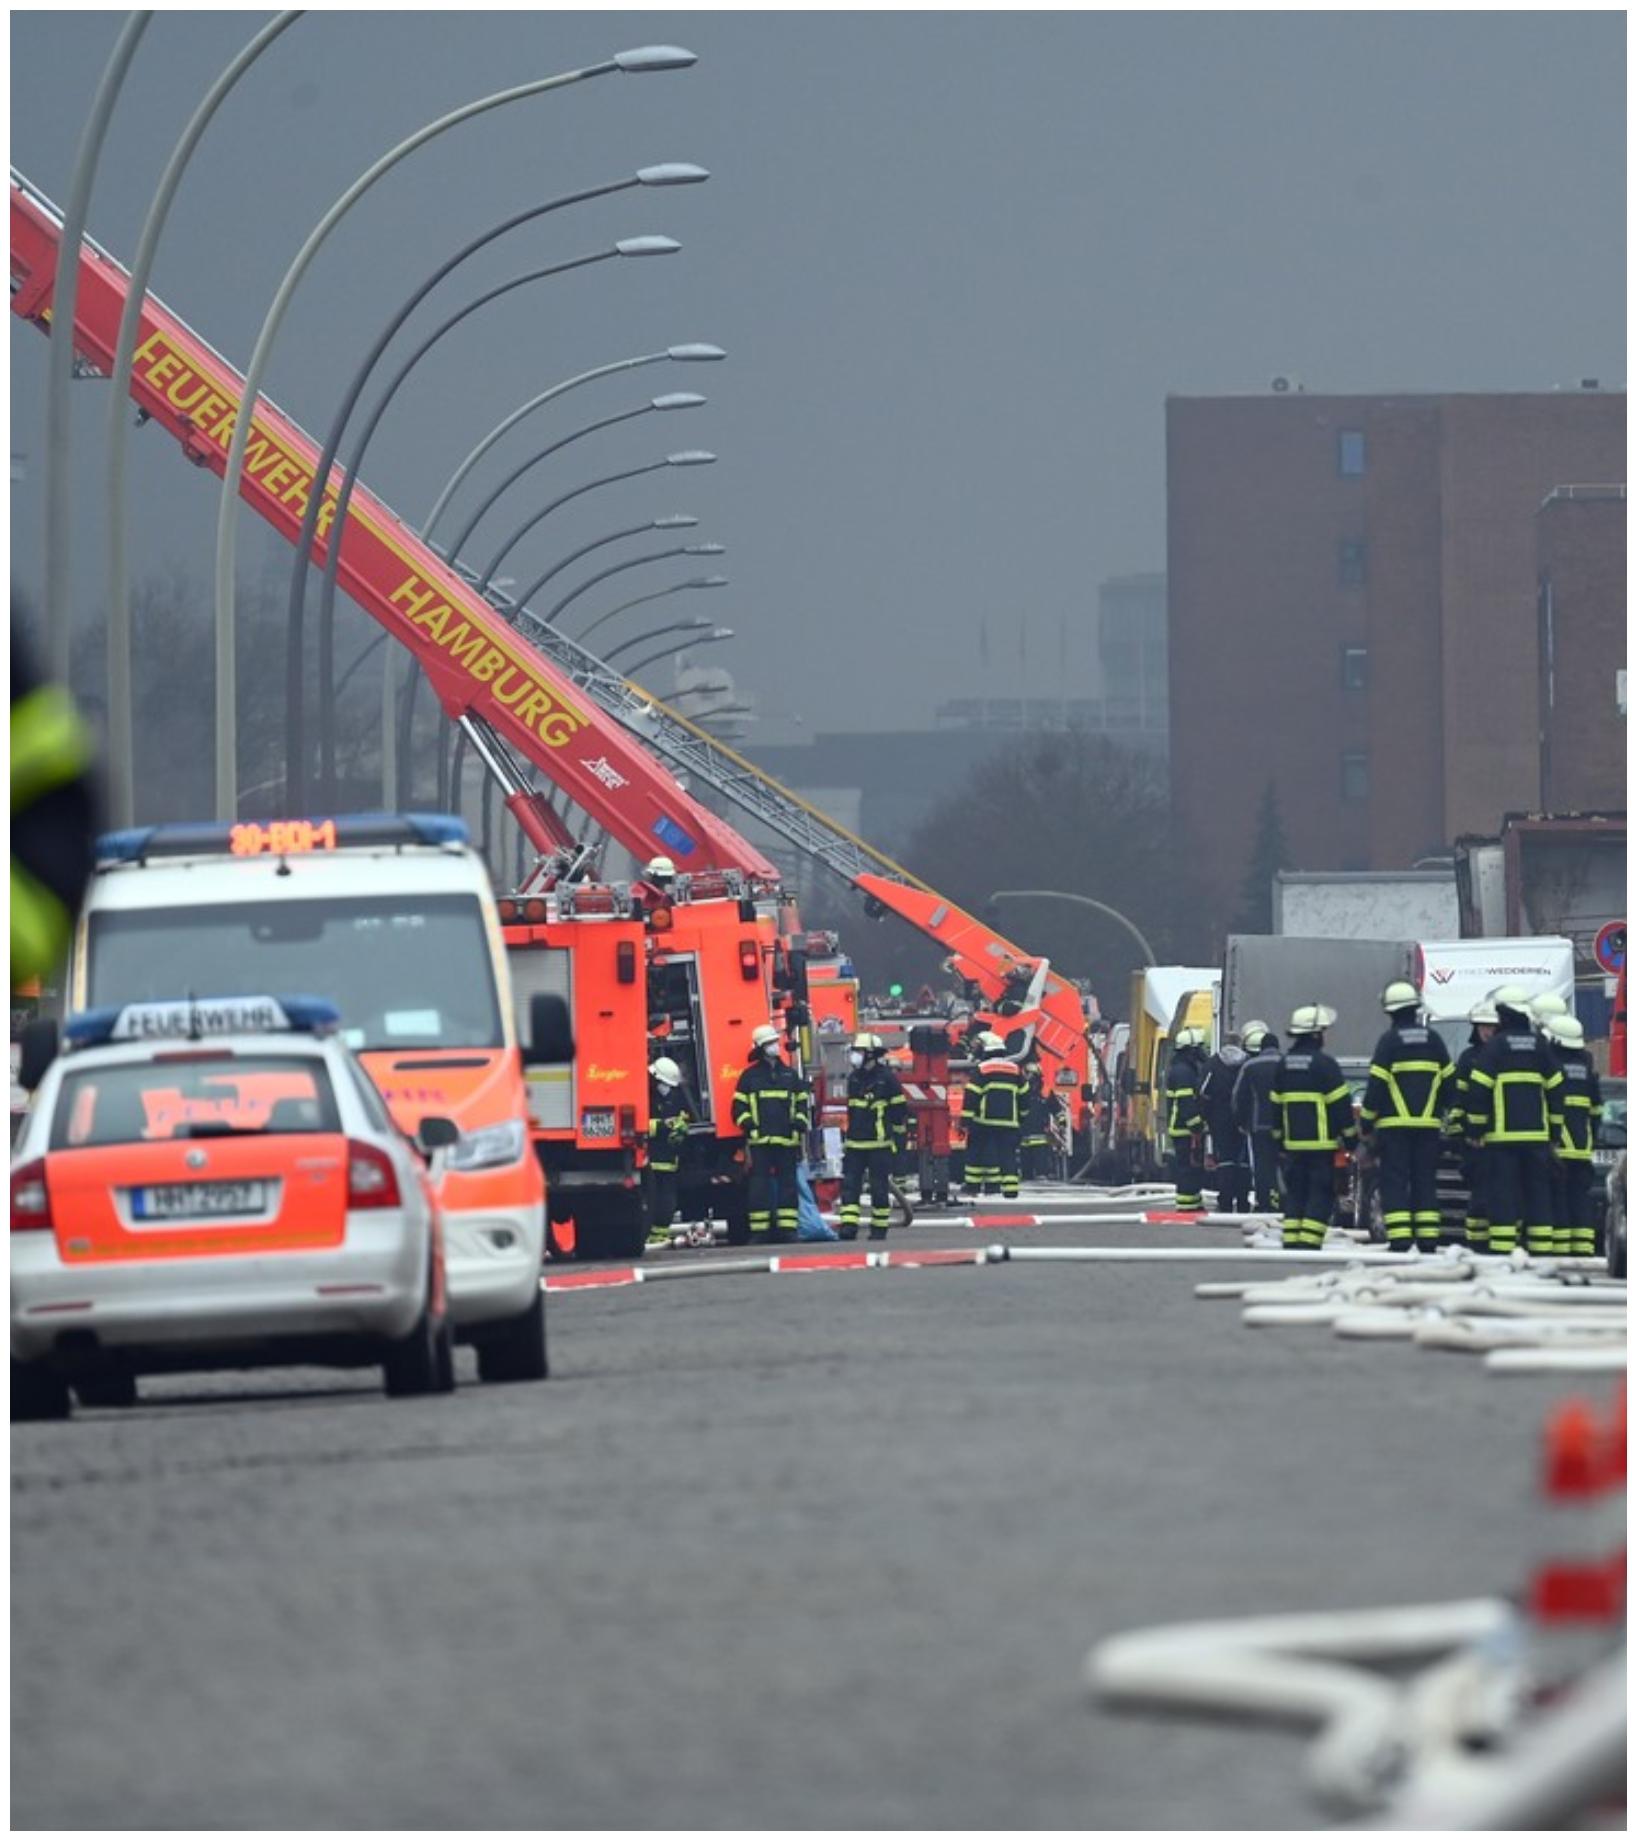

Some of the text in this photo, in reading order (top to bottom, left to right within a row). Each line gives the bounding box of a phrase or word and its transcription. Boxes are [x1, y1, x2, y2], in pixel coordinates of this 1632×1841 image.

[132, 330, 578, 747] FEUERWEHR HAMBURG
[128, 1005, 274, 1035] FEUERWEHR
